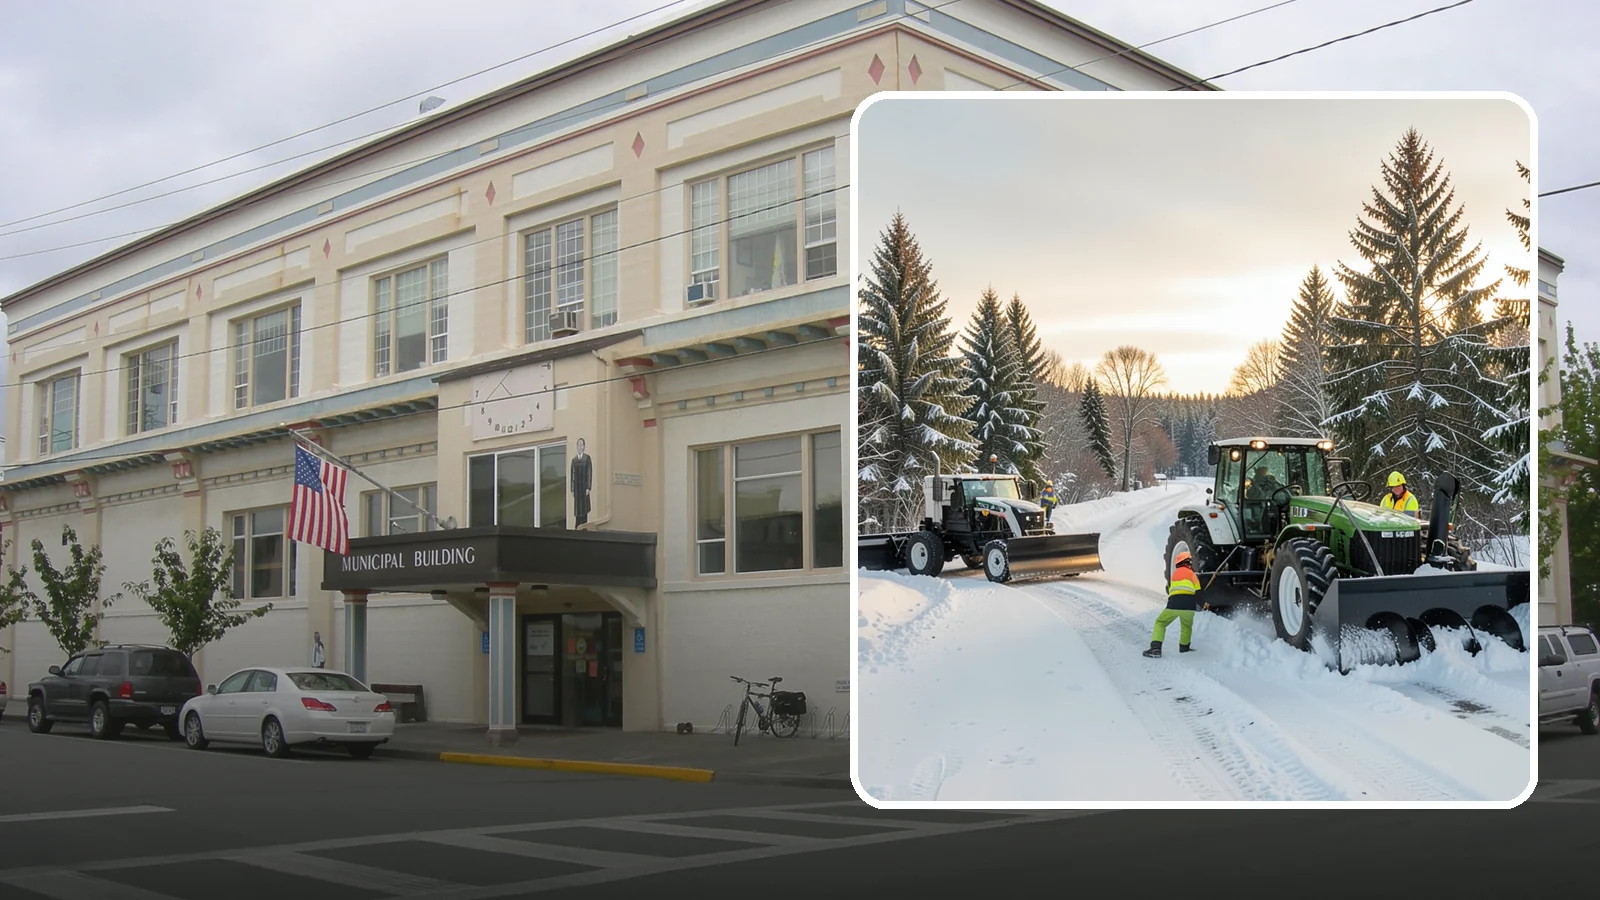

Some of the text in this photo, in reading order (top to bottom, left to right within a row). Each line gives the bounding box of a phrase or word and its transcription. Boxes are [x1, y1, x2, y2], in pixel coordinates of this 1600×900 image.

[546, 362, 551, 370] 6
[481, 407, 485, 415] 8
[529, 414, 533, 422] 3
[495, 424, 500, 432] 10
[342, 546, 475, 572] MUNICIPAL BUILDING
